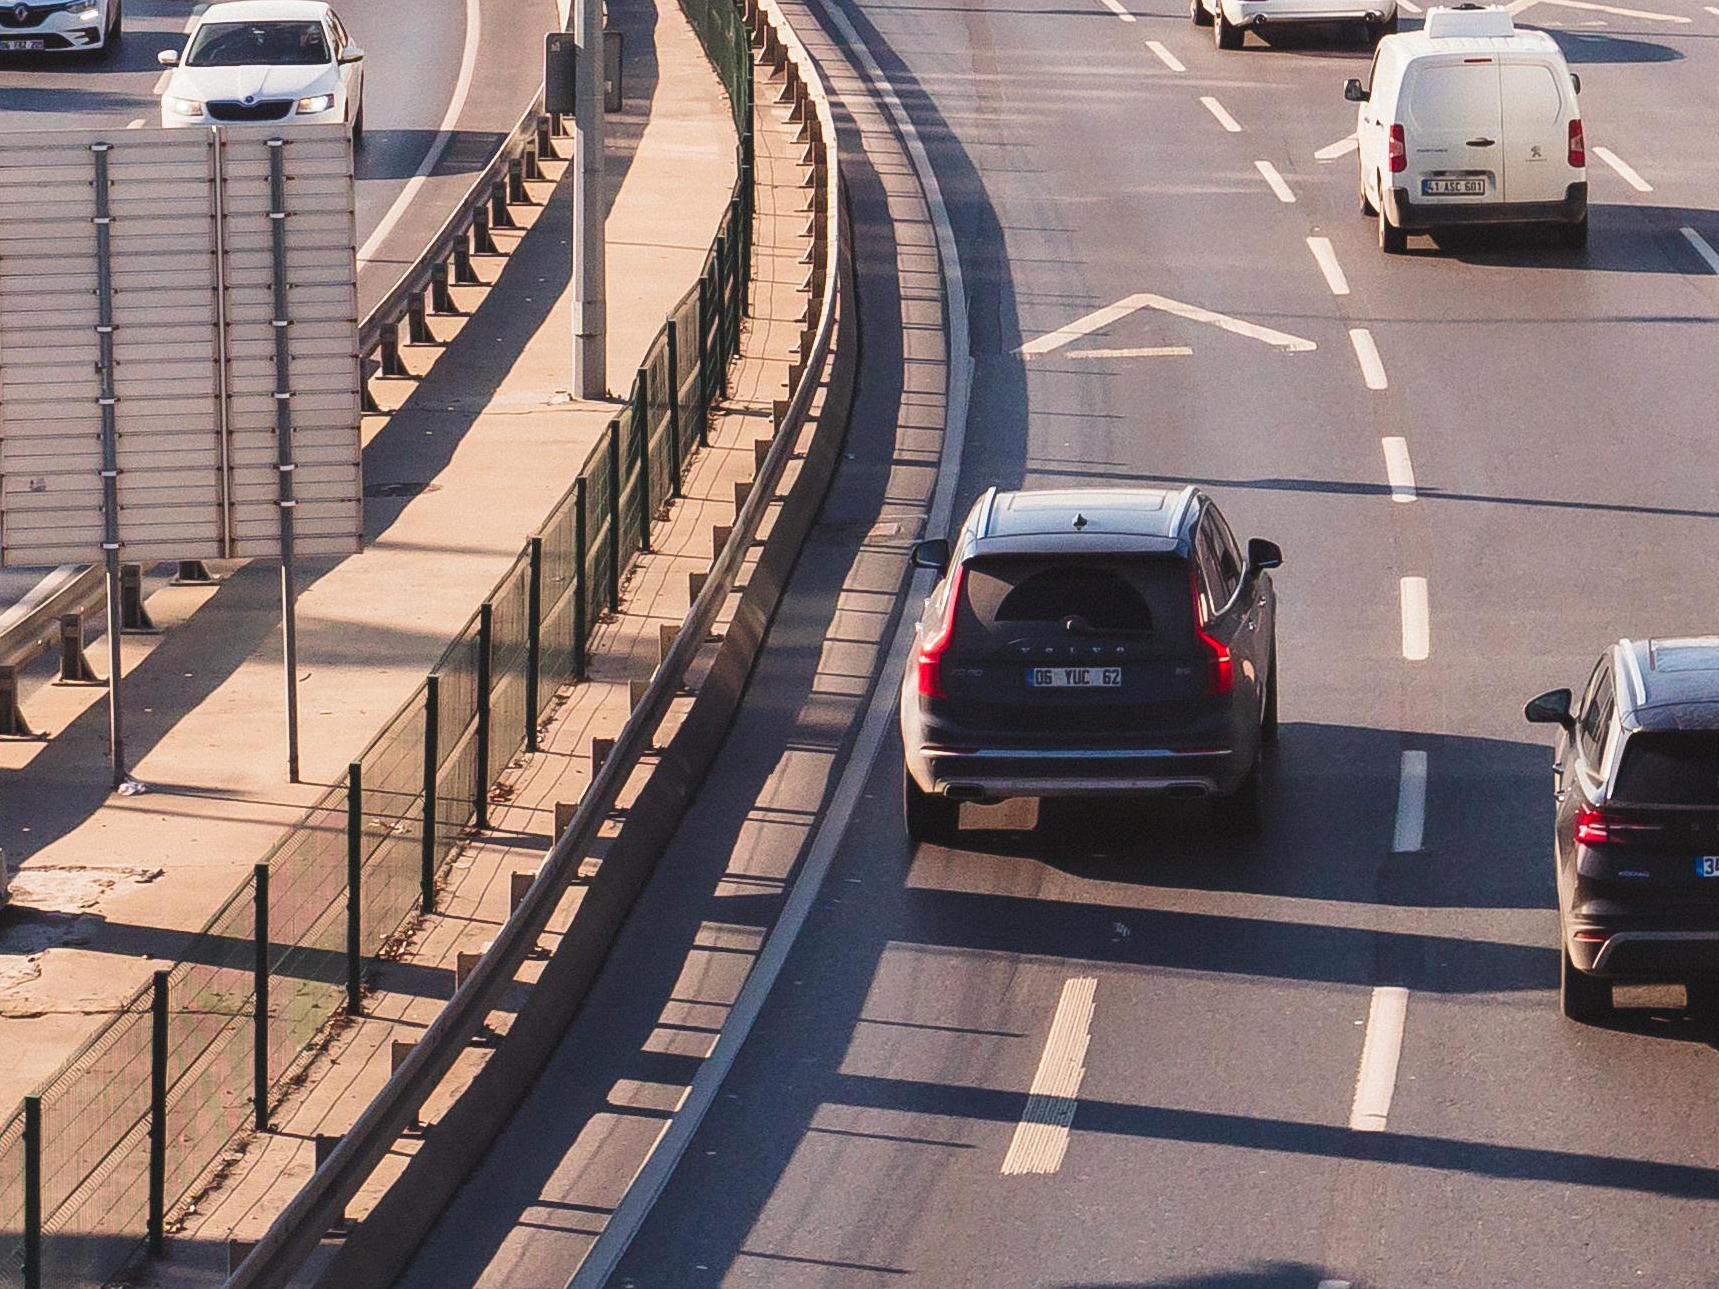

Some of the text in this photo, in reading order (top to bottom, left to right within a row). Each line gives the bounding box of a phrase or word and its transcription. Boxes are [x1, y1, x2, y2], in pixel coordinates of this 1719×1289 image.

[1428, 182, 1482, 191] 41 ASC 601
[1035, 669, 1120, 685] 06 YUC 62
